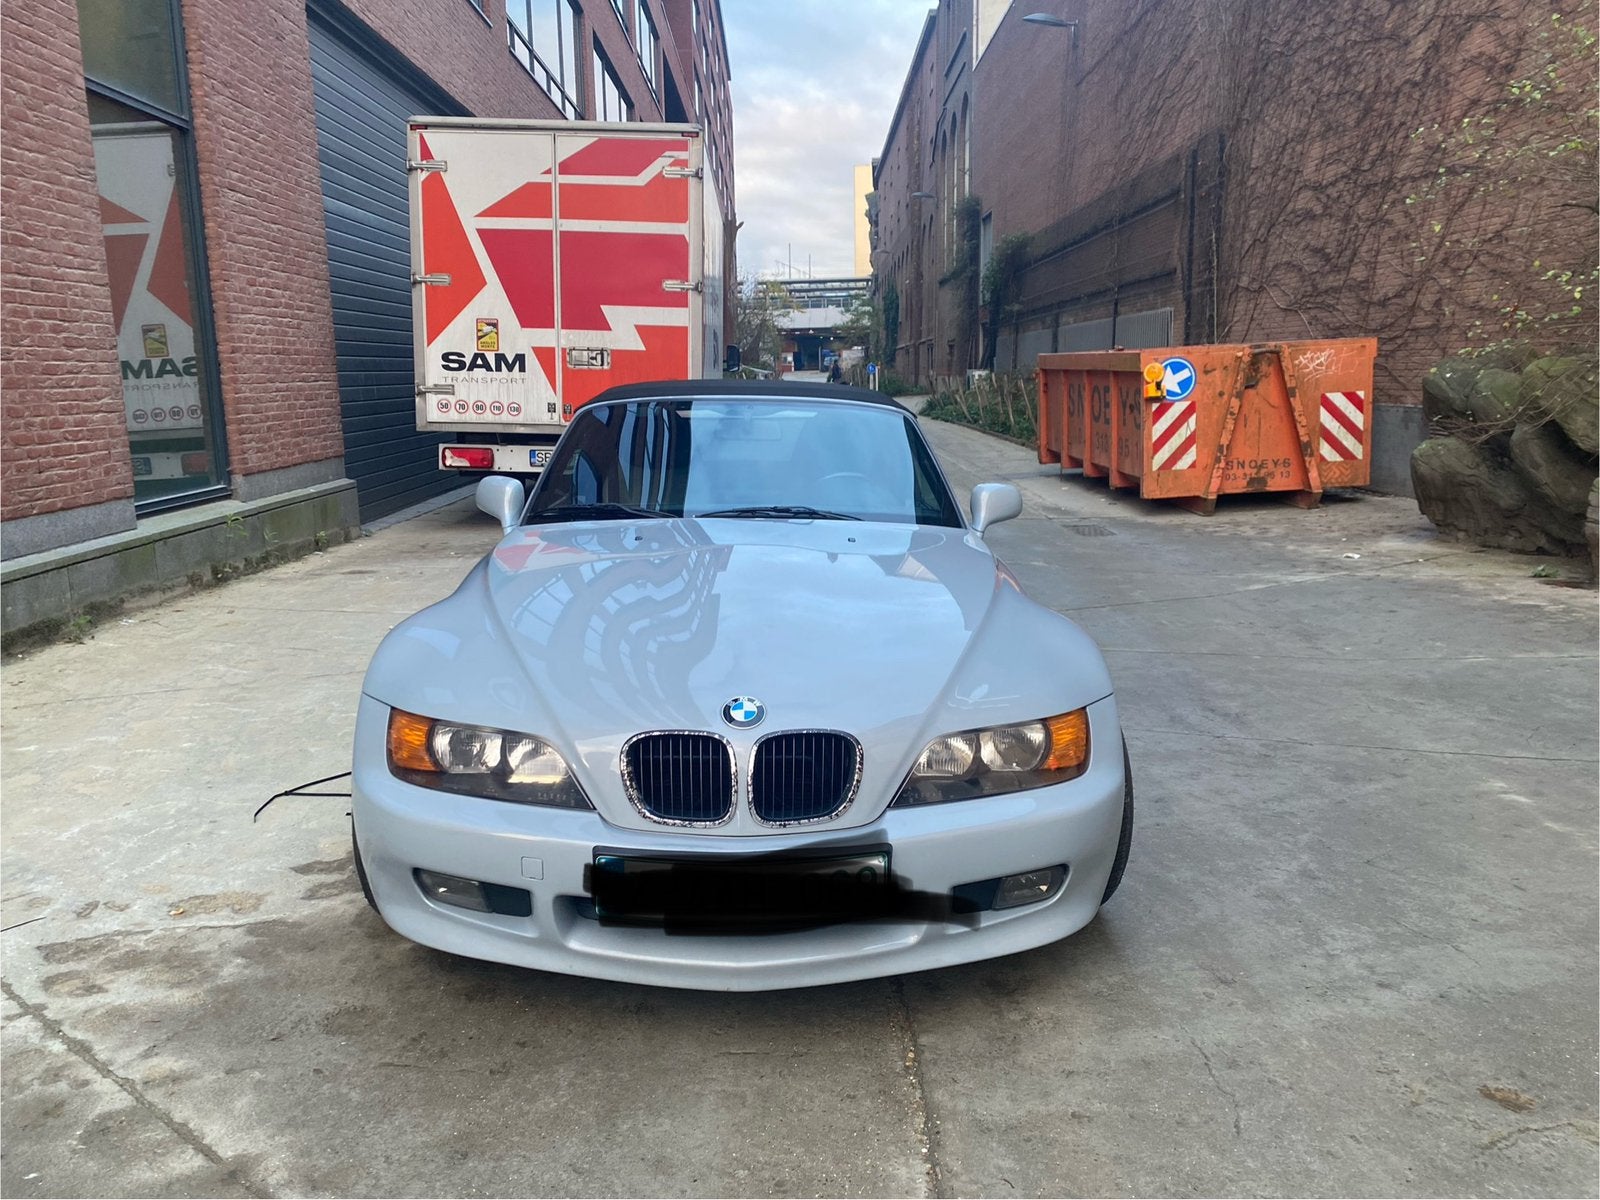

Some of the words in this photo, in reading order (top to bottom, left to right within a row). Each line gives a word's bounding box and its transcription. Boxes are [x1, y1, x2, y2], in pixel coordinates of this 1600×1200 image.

[441, 351, 526, 373] SAM
[442, 376, 527, 385] TRANSPORT
[439, 402, 449, 410] 50
[458, 403, 466, 411] 70
[475, 403, 484, 412] 90
[509, 405, 520, 413] 130
[1225, 458, 1291, 471] SNOEYS
